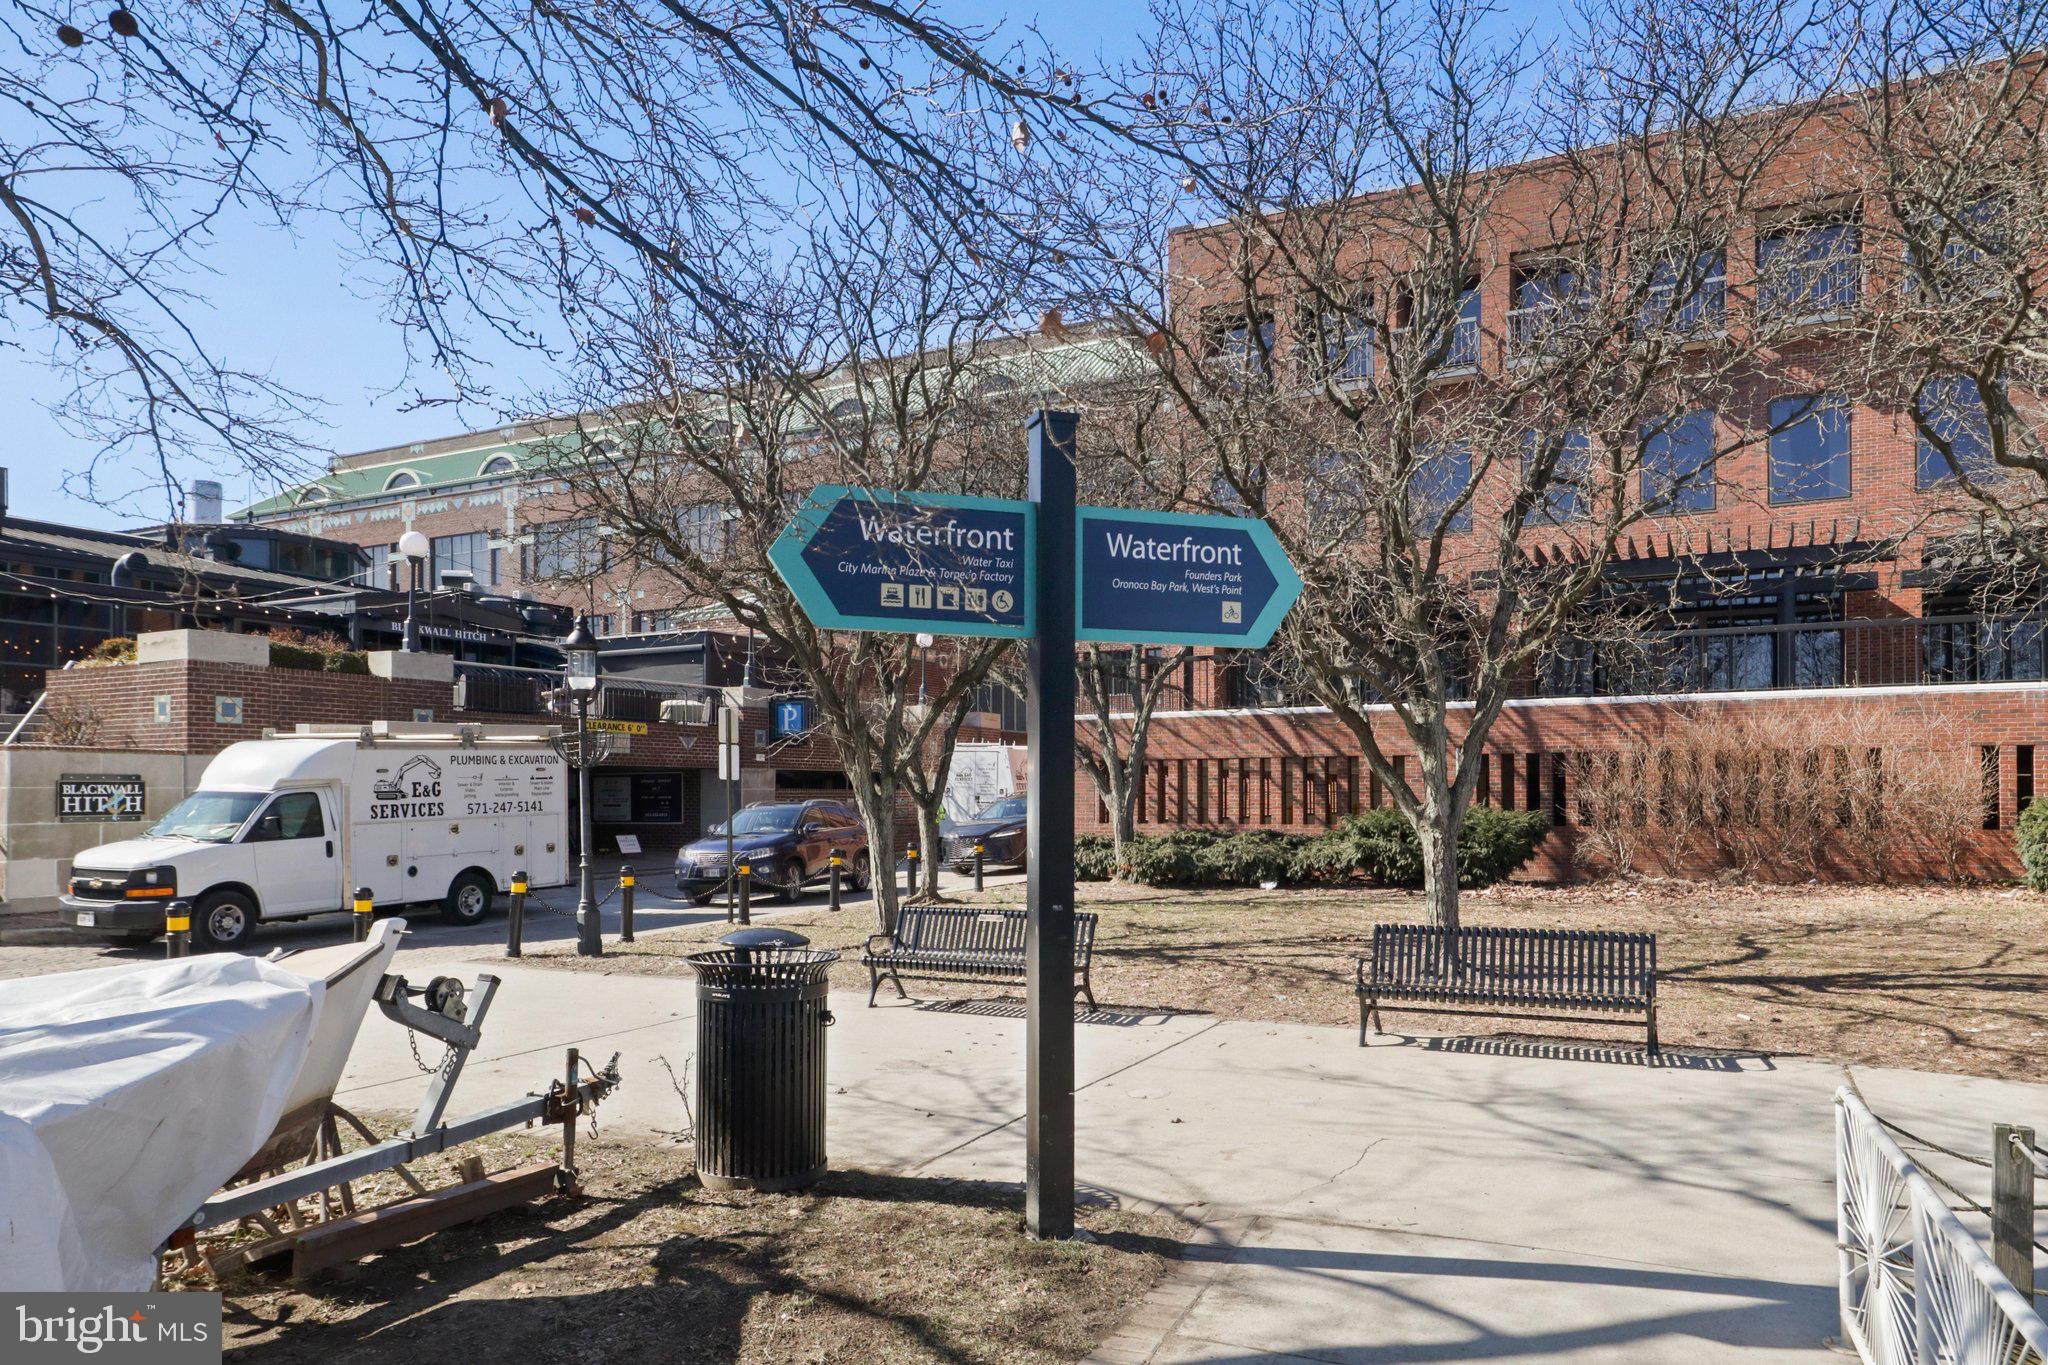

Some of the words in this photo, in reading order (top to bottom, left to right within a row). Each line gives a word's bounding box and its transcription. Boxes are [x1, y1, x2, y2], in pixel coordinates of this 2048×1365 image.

[859, 515, 1014, 550] Waterfront
[1106, 532, 1242, 566] Waterfront
[962, 556, 992, 567] Water
[995, 557, 1014, 568] Taxi
[838, 561, 858, 575] City
[979, 570, 1014, 584] Factory
[1185, 570, 1222, 581] Founders
[1224, 572, 1242, 583] Park
[1112, 578, 1149, 590] Oronoco
[1151, 580, 1167, 593] Bay
[1169, 582, 1189, 593] Park,
[1192, 583, 1220, 594] West's
[1221, 585, 1242, 595] Point
[391, 621, 451, 637] BLKWALL
[454, 629, 487, 642] HITCH
[783, 707, 798, 730] P
[450, 755, 497, 766] PLUMBING
[499, 755, 506, 765] &
[508, 755, 559, 765] EXCAVATION
[61, 784, 143, 795] BLACKWALL
[411, 781, 442, 798] E&G
[61, 796, 143, 813] HITH
[370, 802, 444, 820] SERVICES
[467, 800, 544, 815] 571-247-5141
